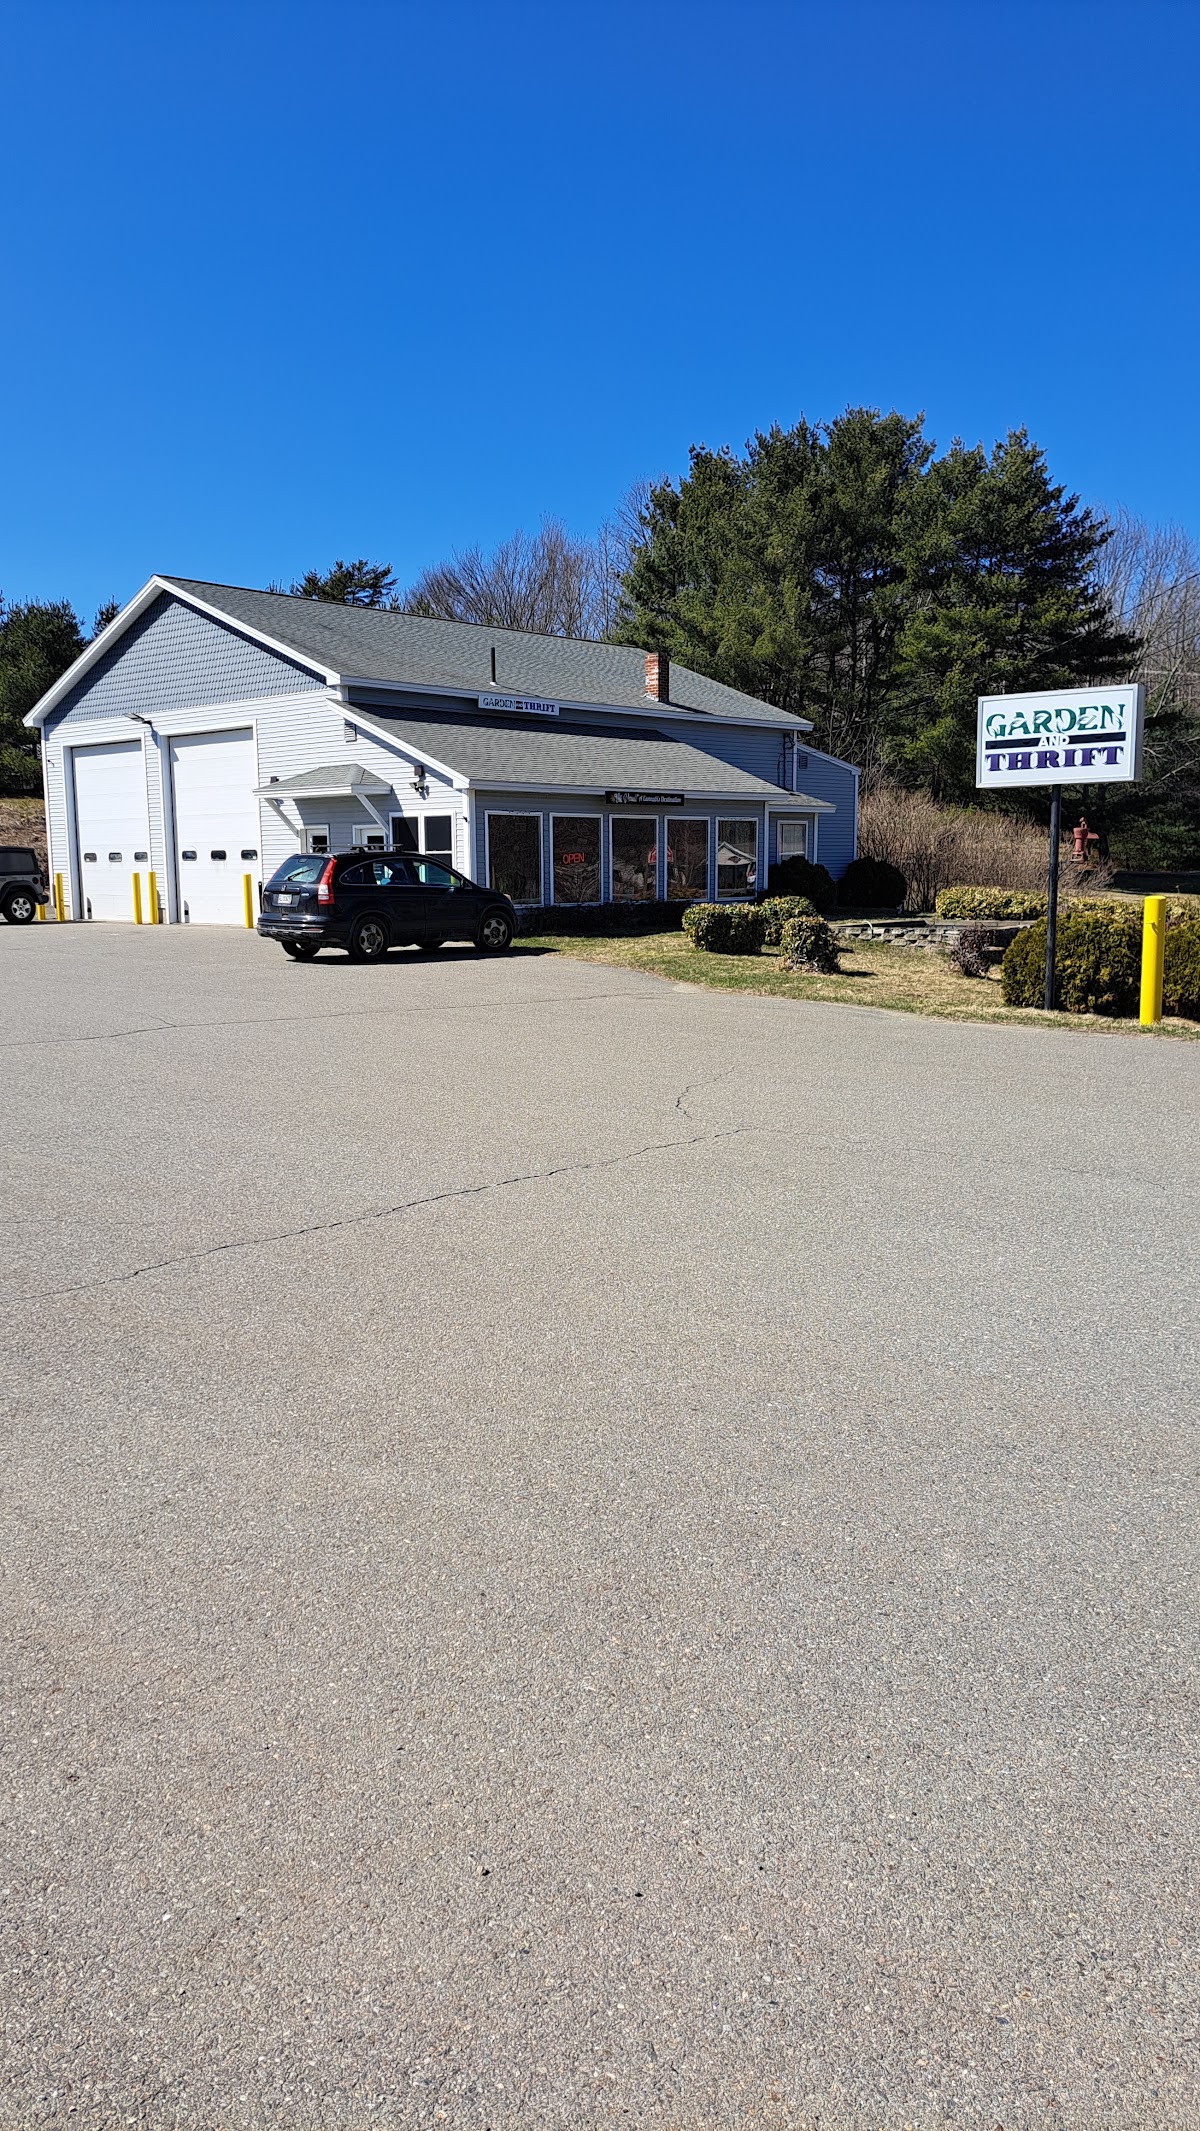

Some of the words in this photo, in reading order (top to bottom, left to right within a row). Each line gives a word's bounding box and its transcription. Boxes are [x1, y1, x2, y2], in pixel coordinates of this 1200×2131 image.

[482, 697, 516, 709] GARDEN
[523, 701, 556, 713] THRIFT
[985, 703, 1126, 738] GARDEN
[1037, 735, 1070, 747] AND
[984, 745, 1125, 772] THRIFT
[562, 852, 585, 865] OPEN
